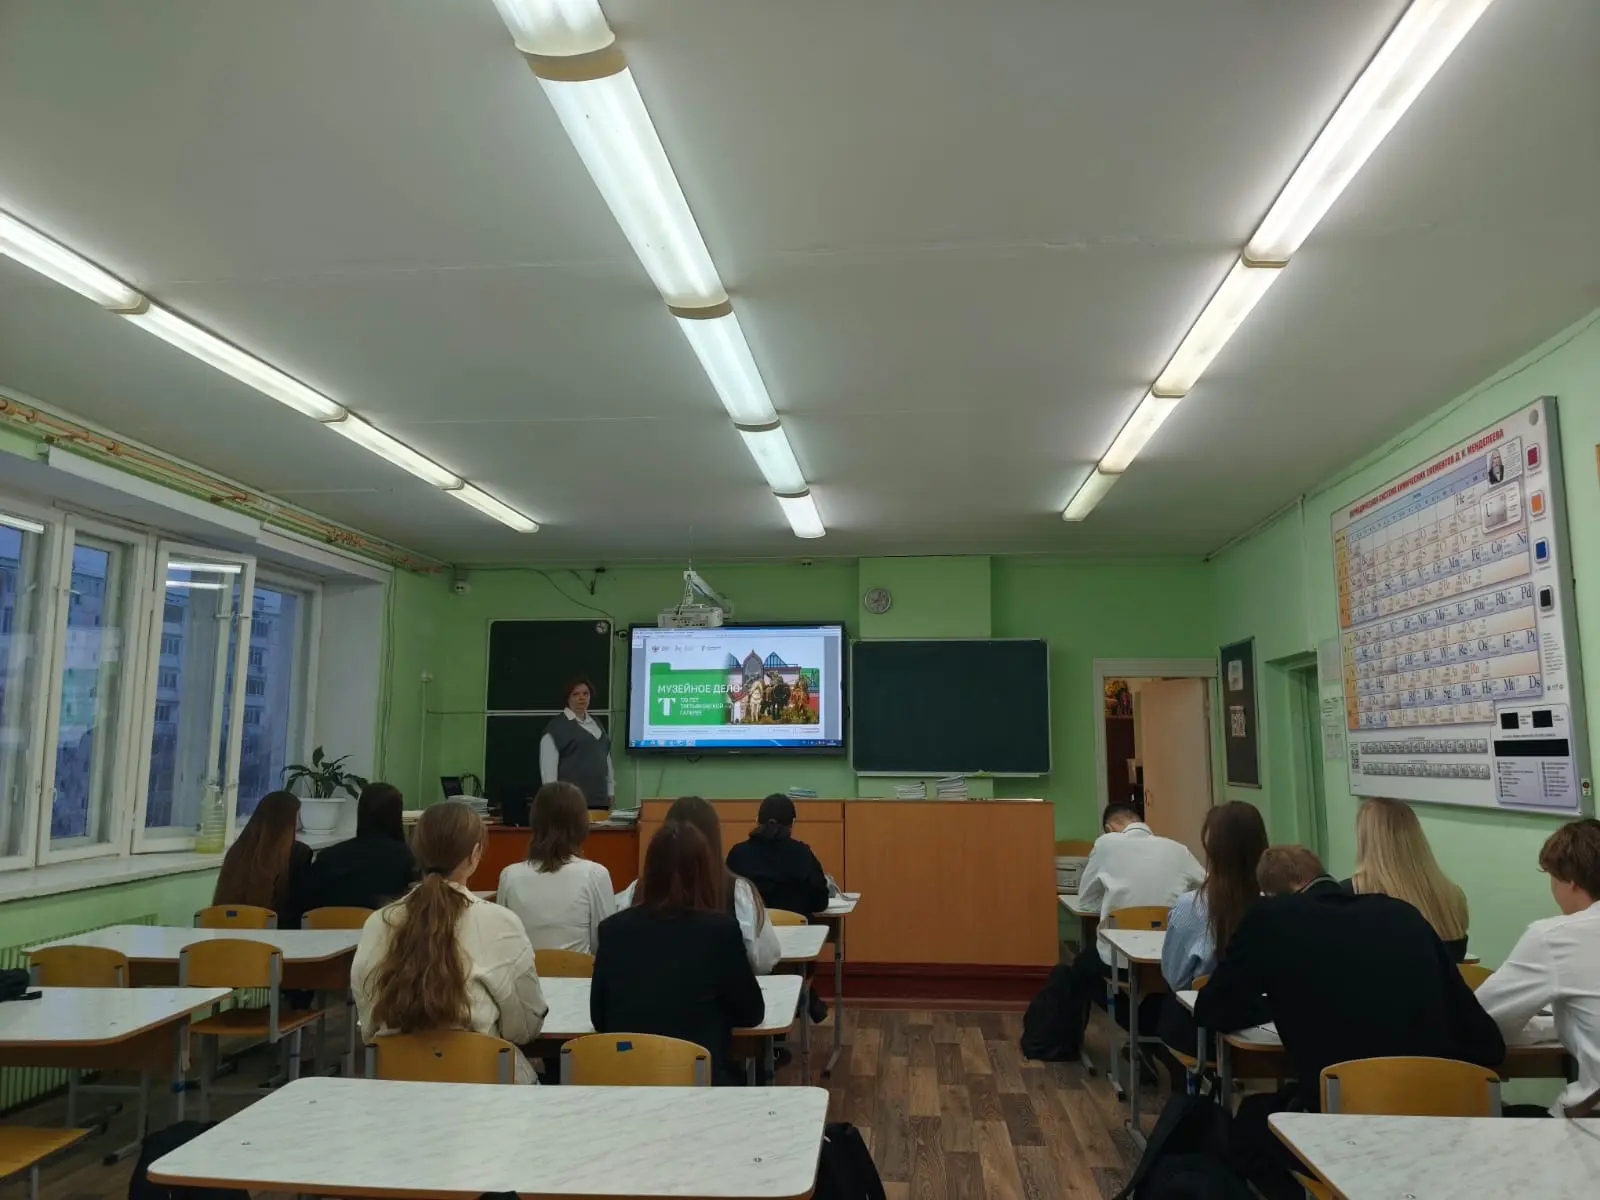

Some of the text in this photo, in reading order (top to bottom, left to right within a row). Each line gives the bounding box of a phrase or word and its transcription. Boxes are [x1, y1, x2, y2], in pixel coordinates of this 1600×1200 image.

[1467, 428, 1504, 454] МЕНДЕЛЕЕВА
[1516, 532, 1527, 544] Ni
[1491, 541, 1502, 553] Co
[1471, 549, 1480, 561] Fe
[1496, 592, 1506, 606] Rh
[1521, 585, 1532, 599] Pd
[1503, 634, 1511, 648] Ir
[1527, 630, 1537, 644] Pt
[657, 683, 741, 694] МУЗЕЙНОЕ ДЕЛО
[1482, 681, 1492, 694] Hs
[1528, 675, 1540, 689] Ds
